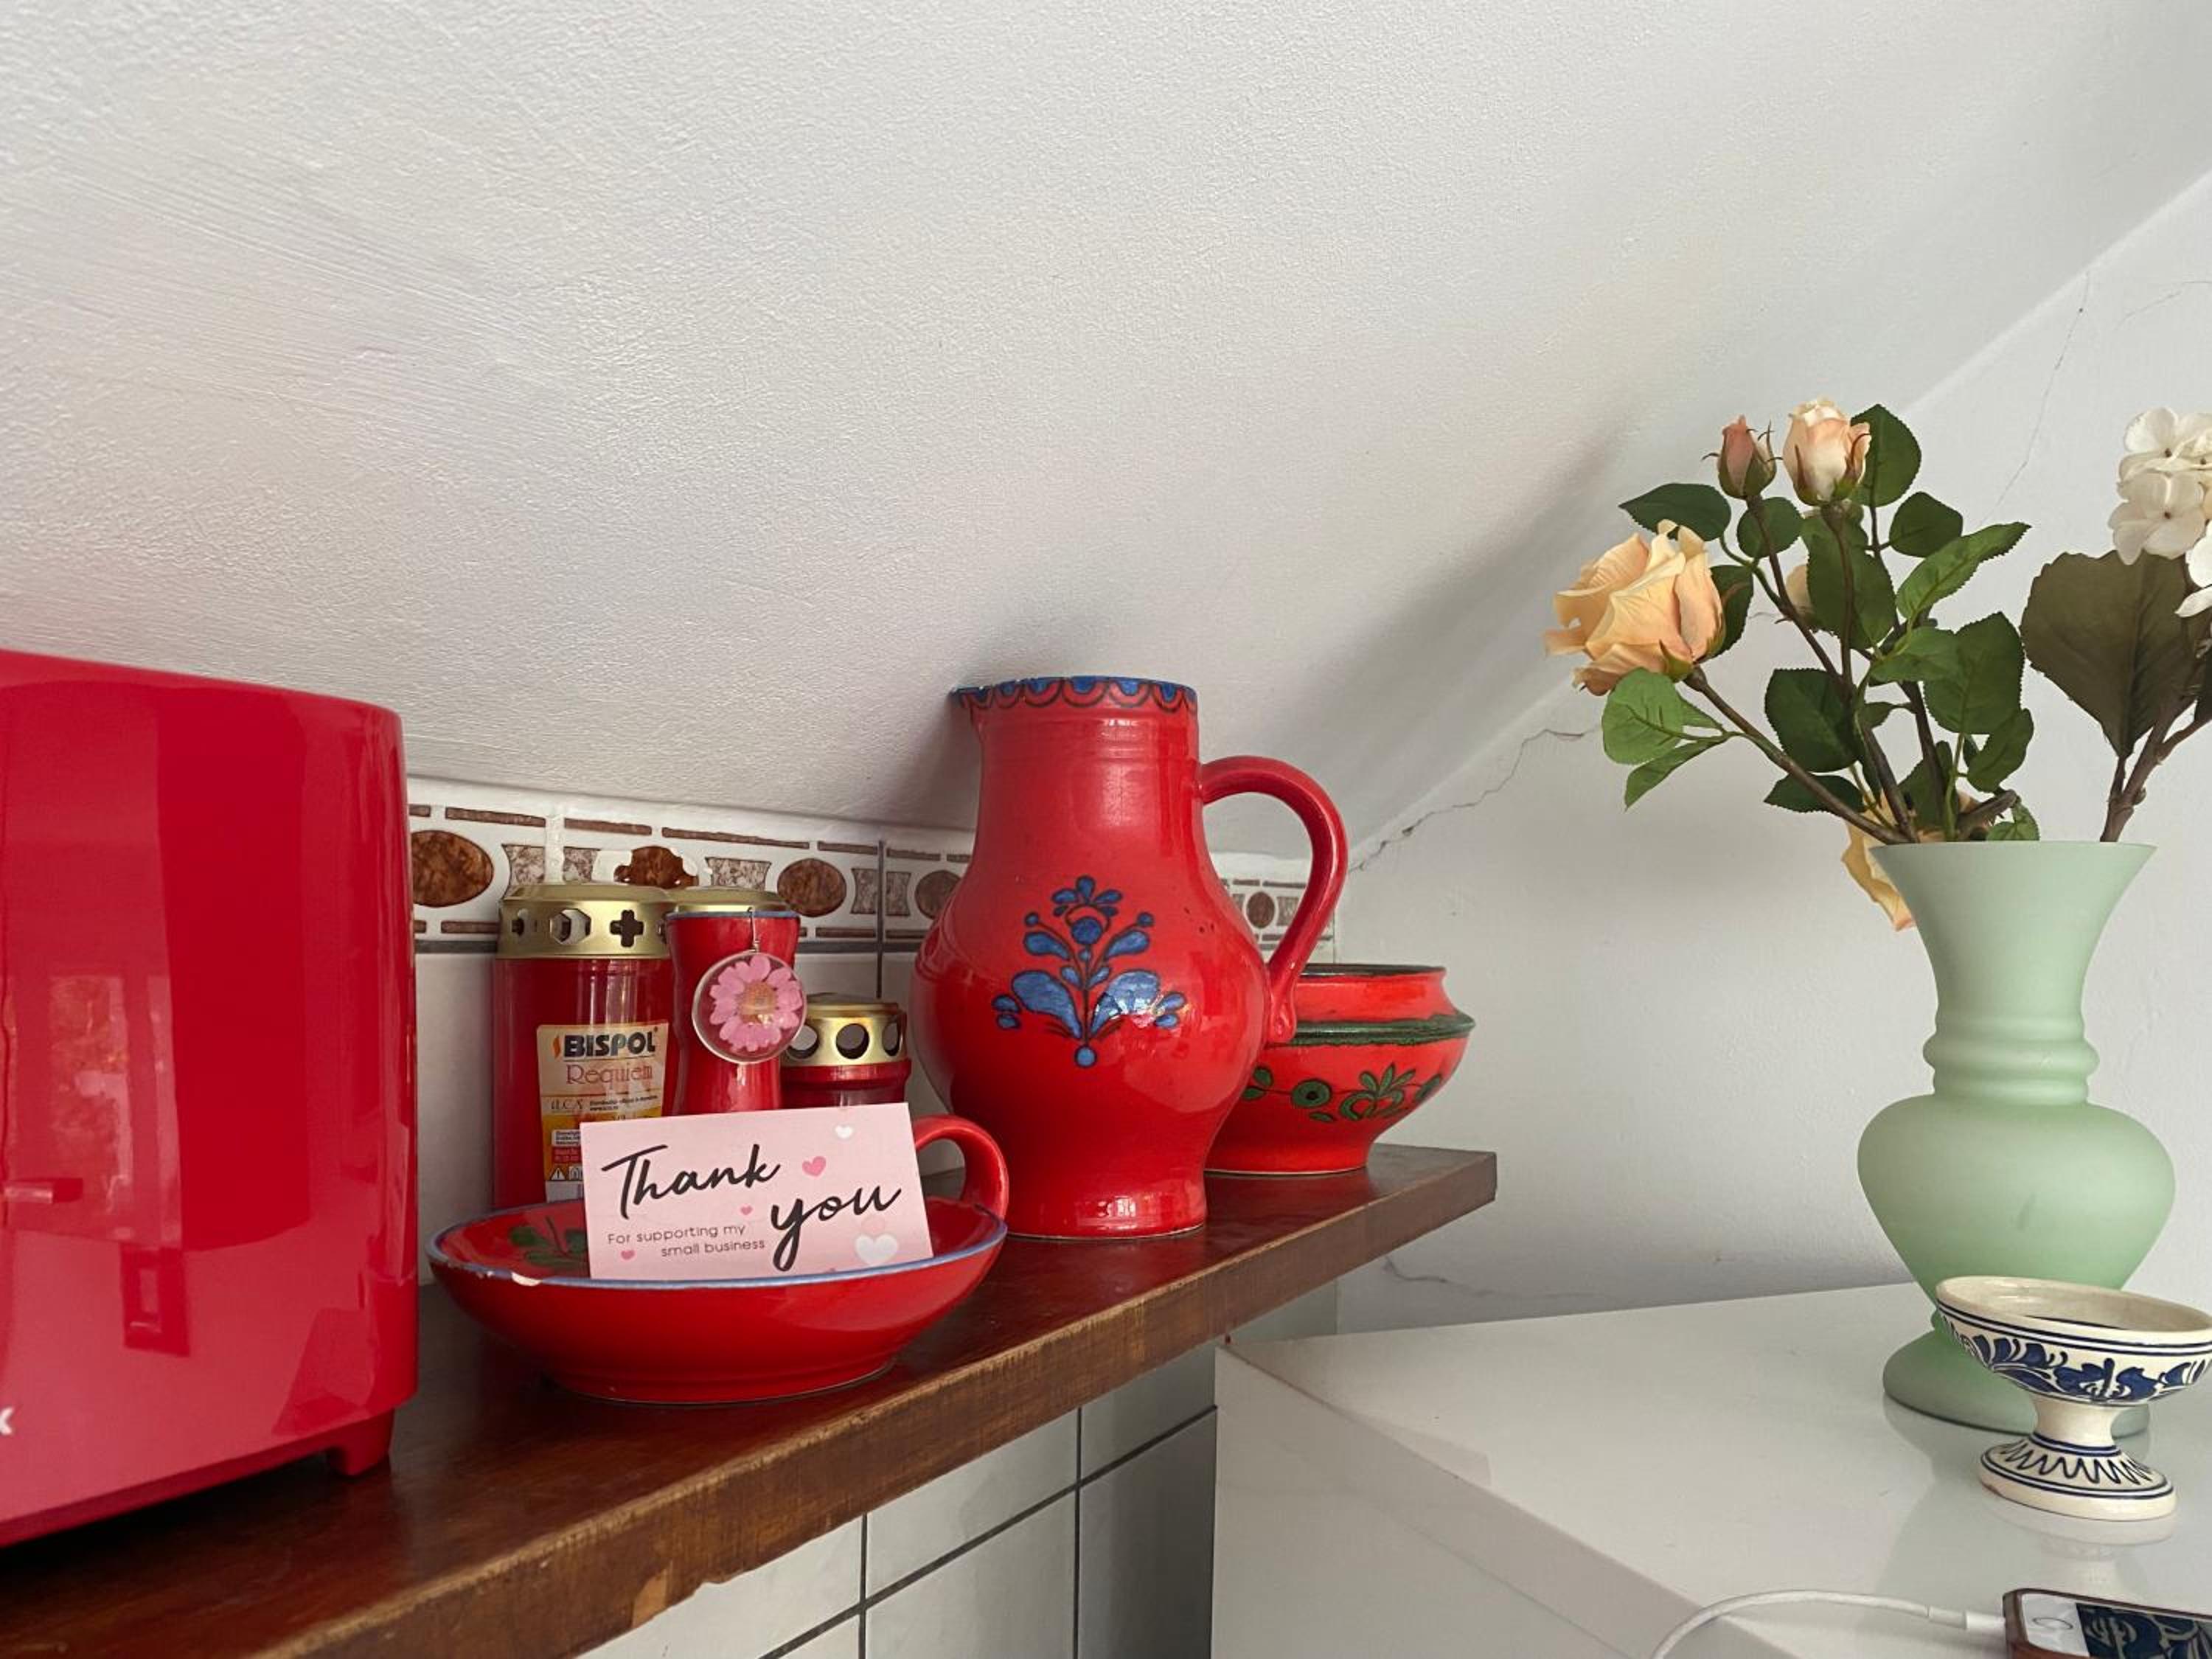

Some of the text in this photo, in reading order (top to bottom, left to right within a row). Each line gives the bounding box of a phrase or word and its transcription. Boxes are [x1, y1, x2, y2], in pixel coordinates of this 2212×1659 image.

[564, 1031, 655, 1057] BISPOL
[566, 1062, 653, 1090] Requiem
[601, 1144, 780, 1220] Thank
[608, 1225, 746, 1245] For supporting my
[771, 1185, 902, 1272] you
[661, 1239, 765, 1257] small business
